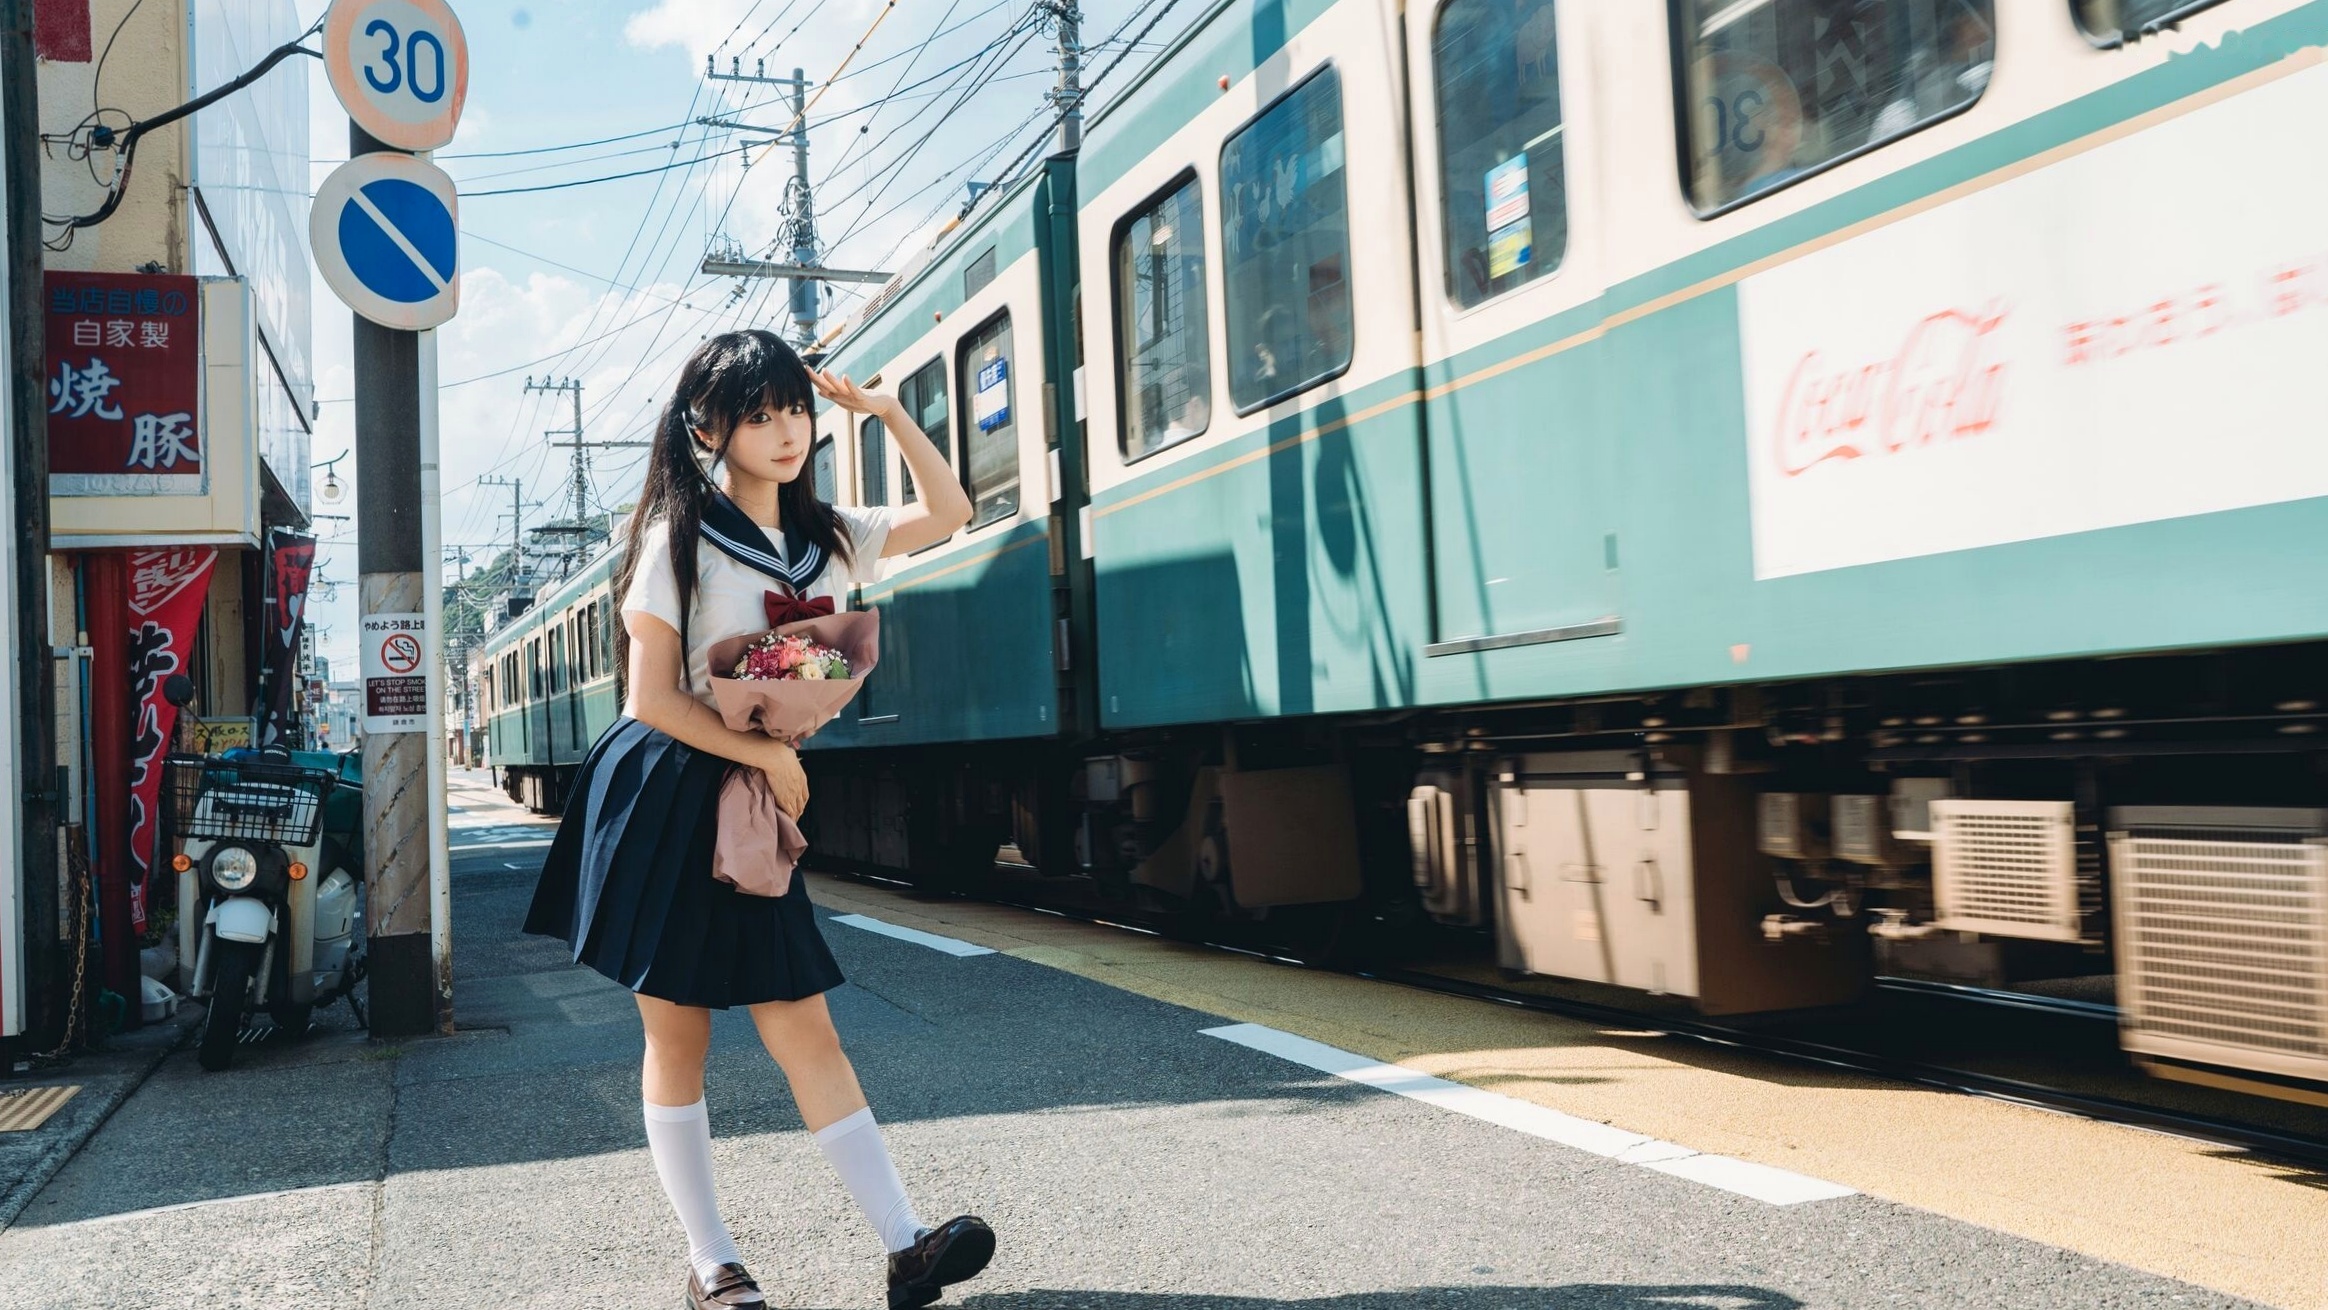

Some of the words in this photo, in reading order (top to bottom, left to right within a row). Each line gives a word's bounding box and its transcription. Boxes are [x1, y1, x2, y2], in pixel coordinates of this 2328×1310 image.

[364, 19, 445, 103] 30
[52, 287, 188, 316] 当店自慢の
[73, 319, 170, 349] 自家製
[49, 357, 200, 470] 焼豚
[364, 619, 425, 632] やめよう路上
[368, 679, 386, 687] LET'S
[386, 679, 406, 687] STOP
[406, 678, 426, 686] SMOK
[387, 686, 402, 694] THE
[403, 685, 425, 693] STREE
[264, 748, 288, 757] HONDA
